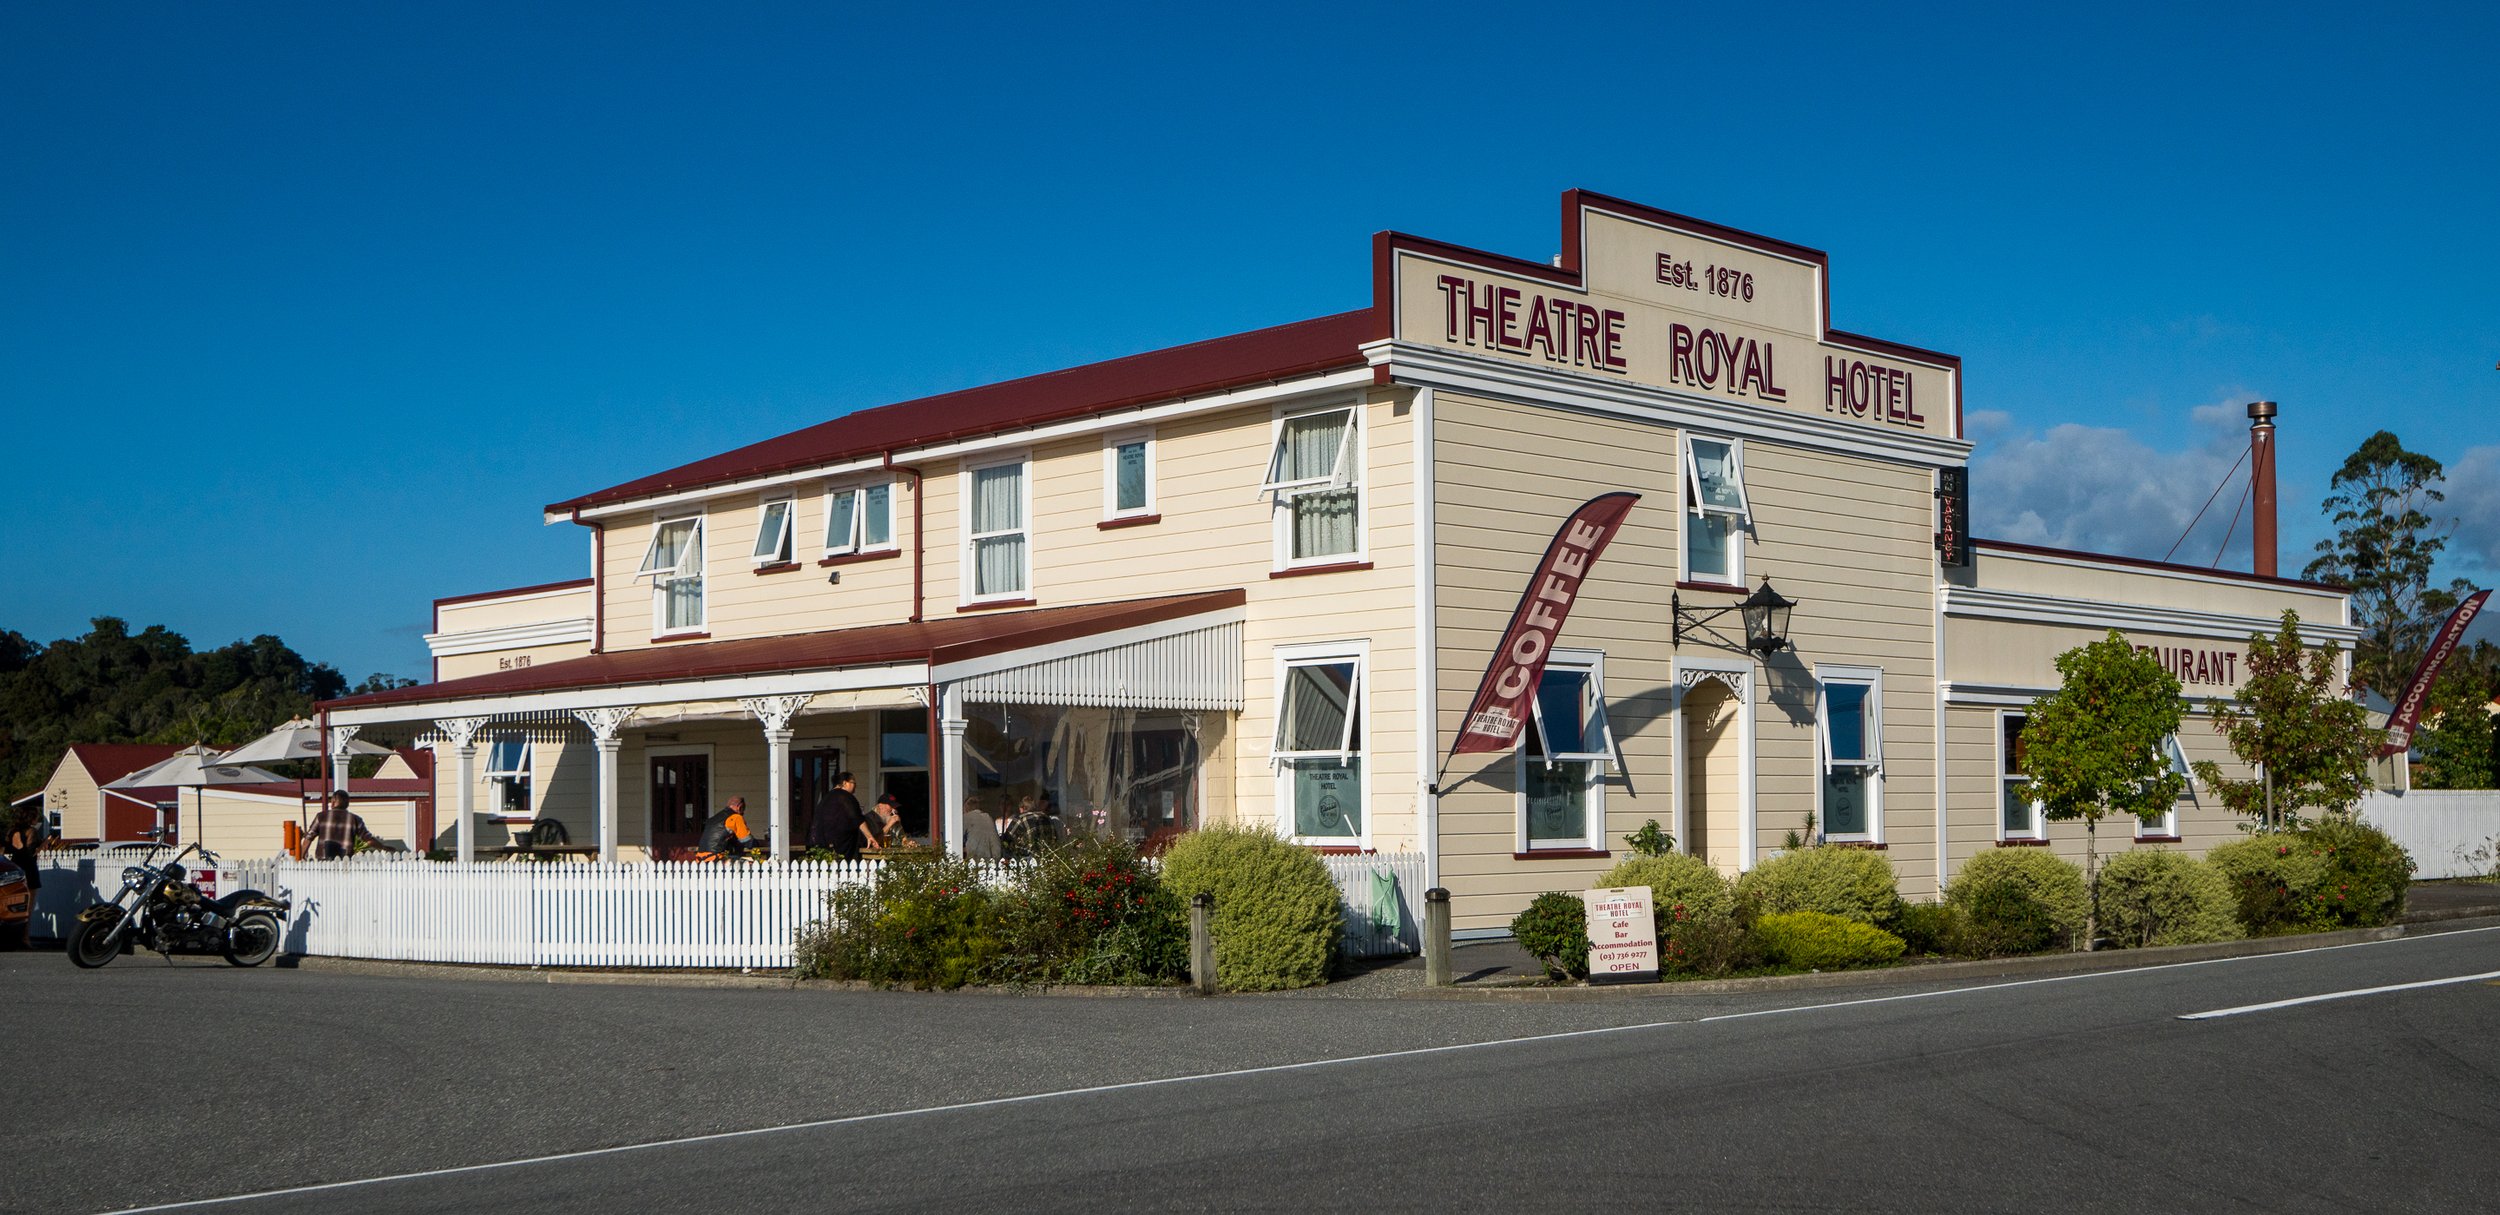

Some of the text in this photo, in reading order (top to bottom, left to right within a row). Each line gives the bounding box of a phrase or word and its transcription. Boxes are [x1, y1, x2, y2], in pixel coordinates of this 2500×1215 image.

[1656, 252, 1754, 303] Est. 1876
[1438, 274, 1925, 429] THEATRE ROYAL HOTEL
[1944, 496, 1953, 560] VACANCY
[1496, 518, 1606, 699] COFFEE
[515, 655, 531, 668] 1876
[2128, 644, 2237, 687] AURANT
[2399, 599, 2480, 724] ACCOMMODATION
[1497, 717, 1516, 728] ROYAL
[1482, 724, 1500, 734] HOTEL
[1333, 772, 1348, 780] ROYAL
[1595, 901, 1643, 912] THEATRE ROYAL
[1610, 909, 1629, 917] HOTEL
[1612, 921, 1629, 929] Cafe
[1614, 931, 1628, 939] Bar
[1592, 939, 1653, 950] Accommodation
[1599, 951, 1648, 961] (03) 736 9277
[1610, 963, 1640, 972] OPEN
